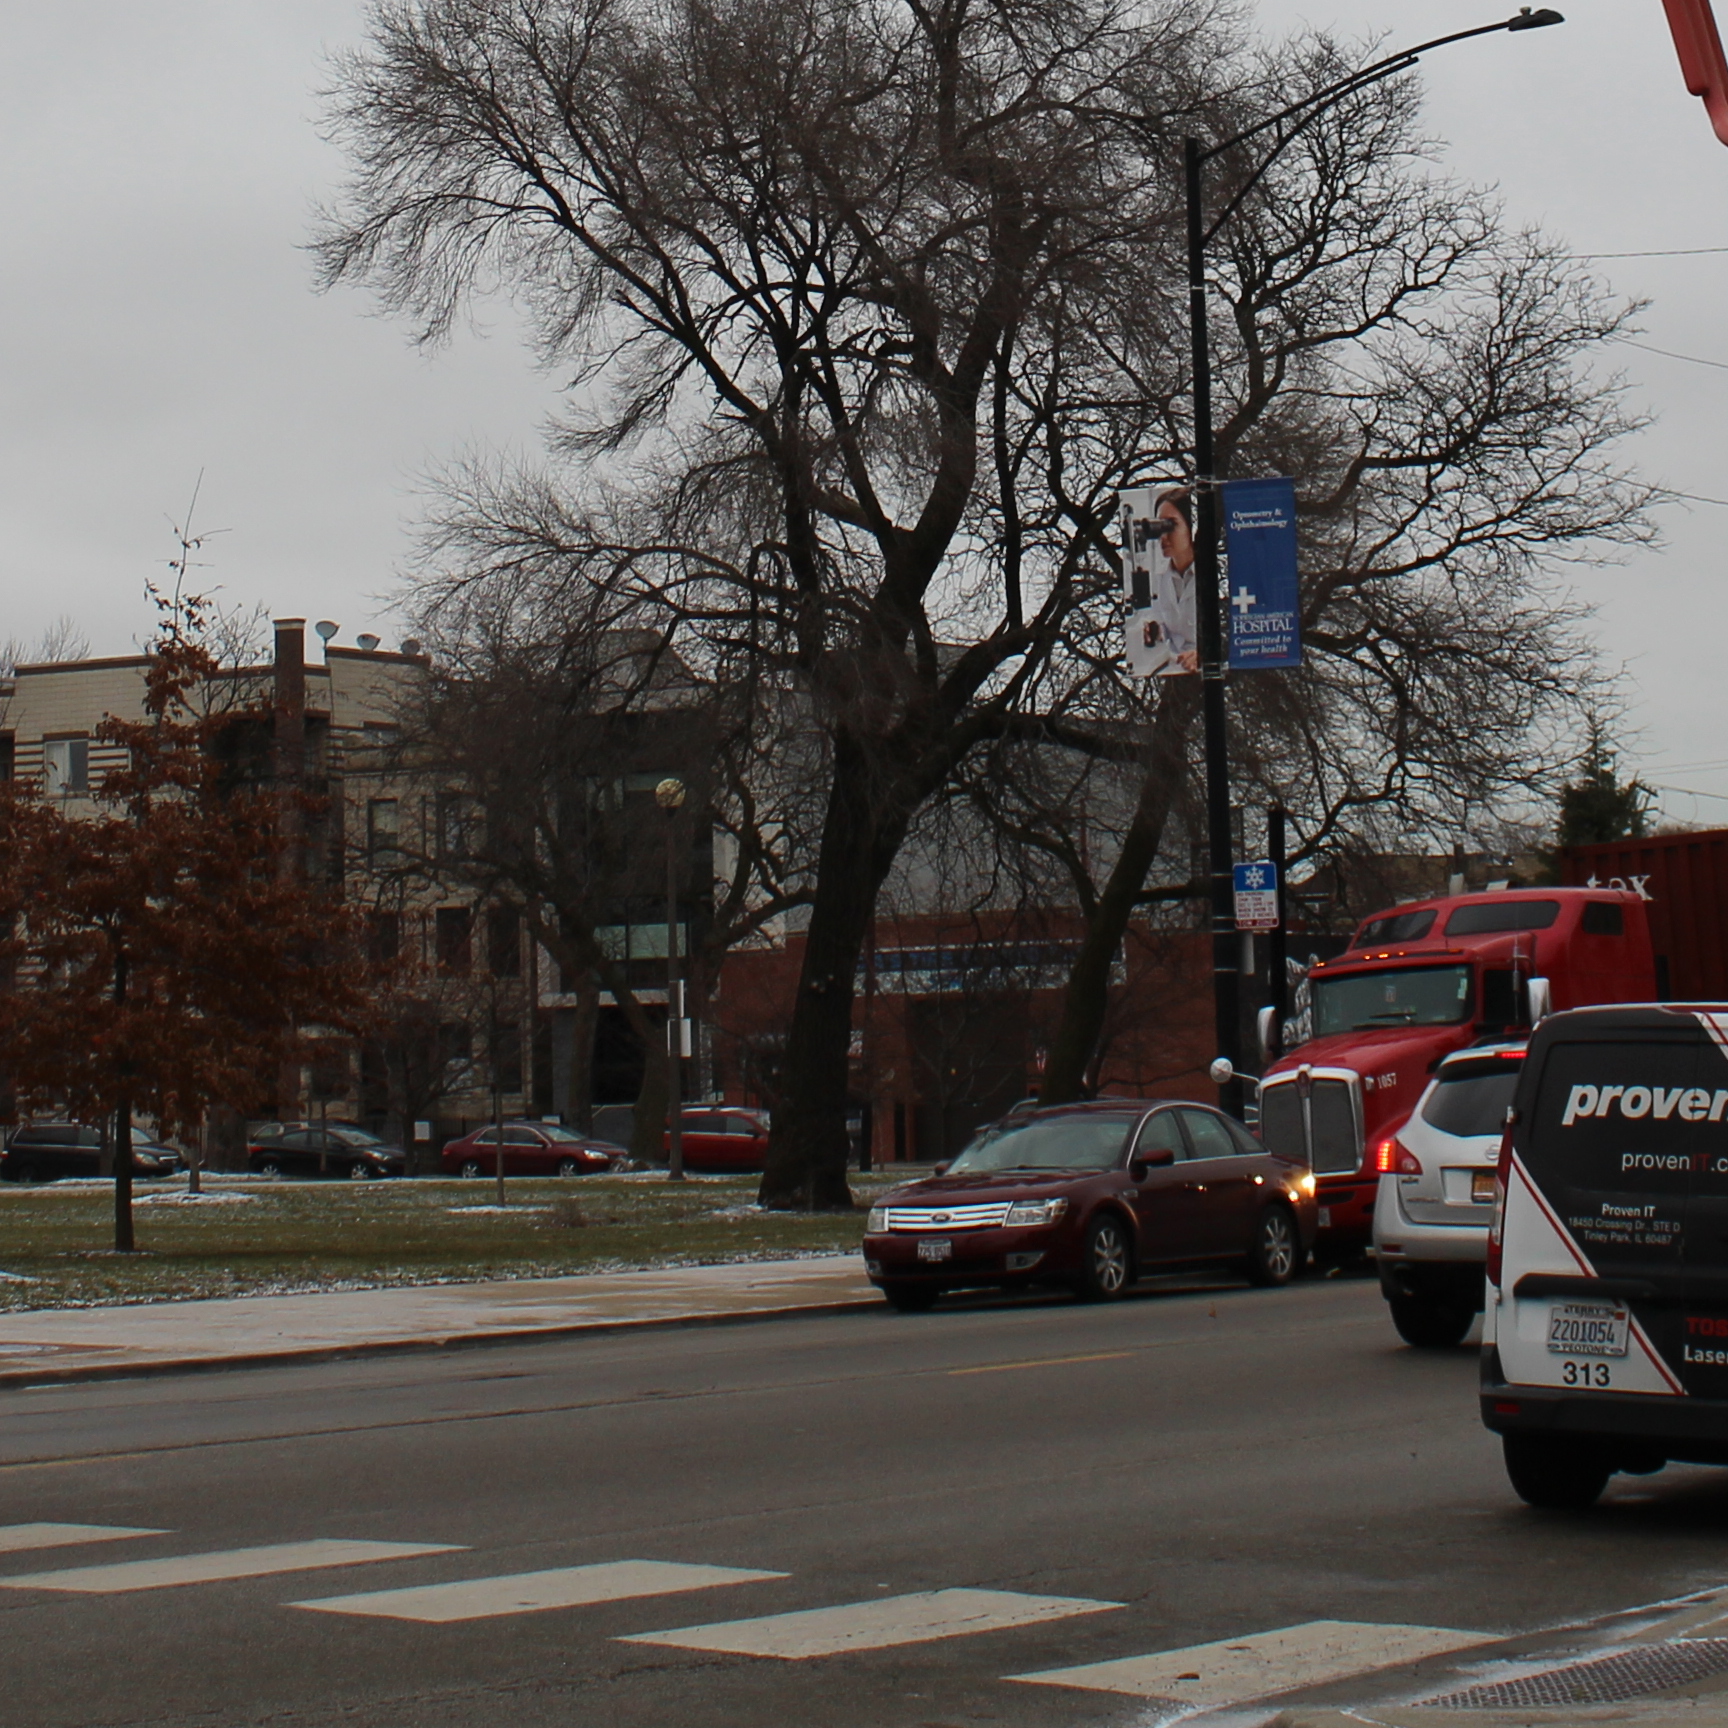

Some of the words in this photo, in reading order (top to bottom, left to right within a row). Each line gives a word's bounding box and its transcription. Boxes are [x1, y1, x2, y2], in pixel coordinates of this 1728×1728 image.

[1274, 508, 1282, 516] &
[1233, 617, 1294, 634] HOSPITAL
[1234, 635, 1281, 646] Committed
[1283, 635, 1292, 643] to
[1240, 647, 1260, 657] your
[1261, 643, 1288, 653] health
[1377, 1072, 1397, 1090] 1057
[1602, 1203, 1641, 1218] Proven
[1643, 1204, 1656, 1218] IT
[1569, 1216, 1594, 1228] 18450
[1595, 1217, 1633, 1231] Crossing
[1653, 1221, 1671, 1232] STE
[1673, 1222, 1681, 1233] D
[1584, 1229, 1608, 1243] Tinley
[1634, 1232, 1643, 1244] IL
[1551, 1317, 1615, 1344] 2201054
[1562, 1361, 1611, 1387] 313
